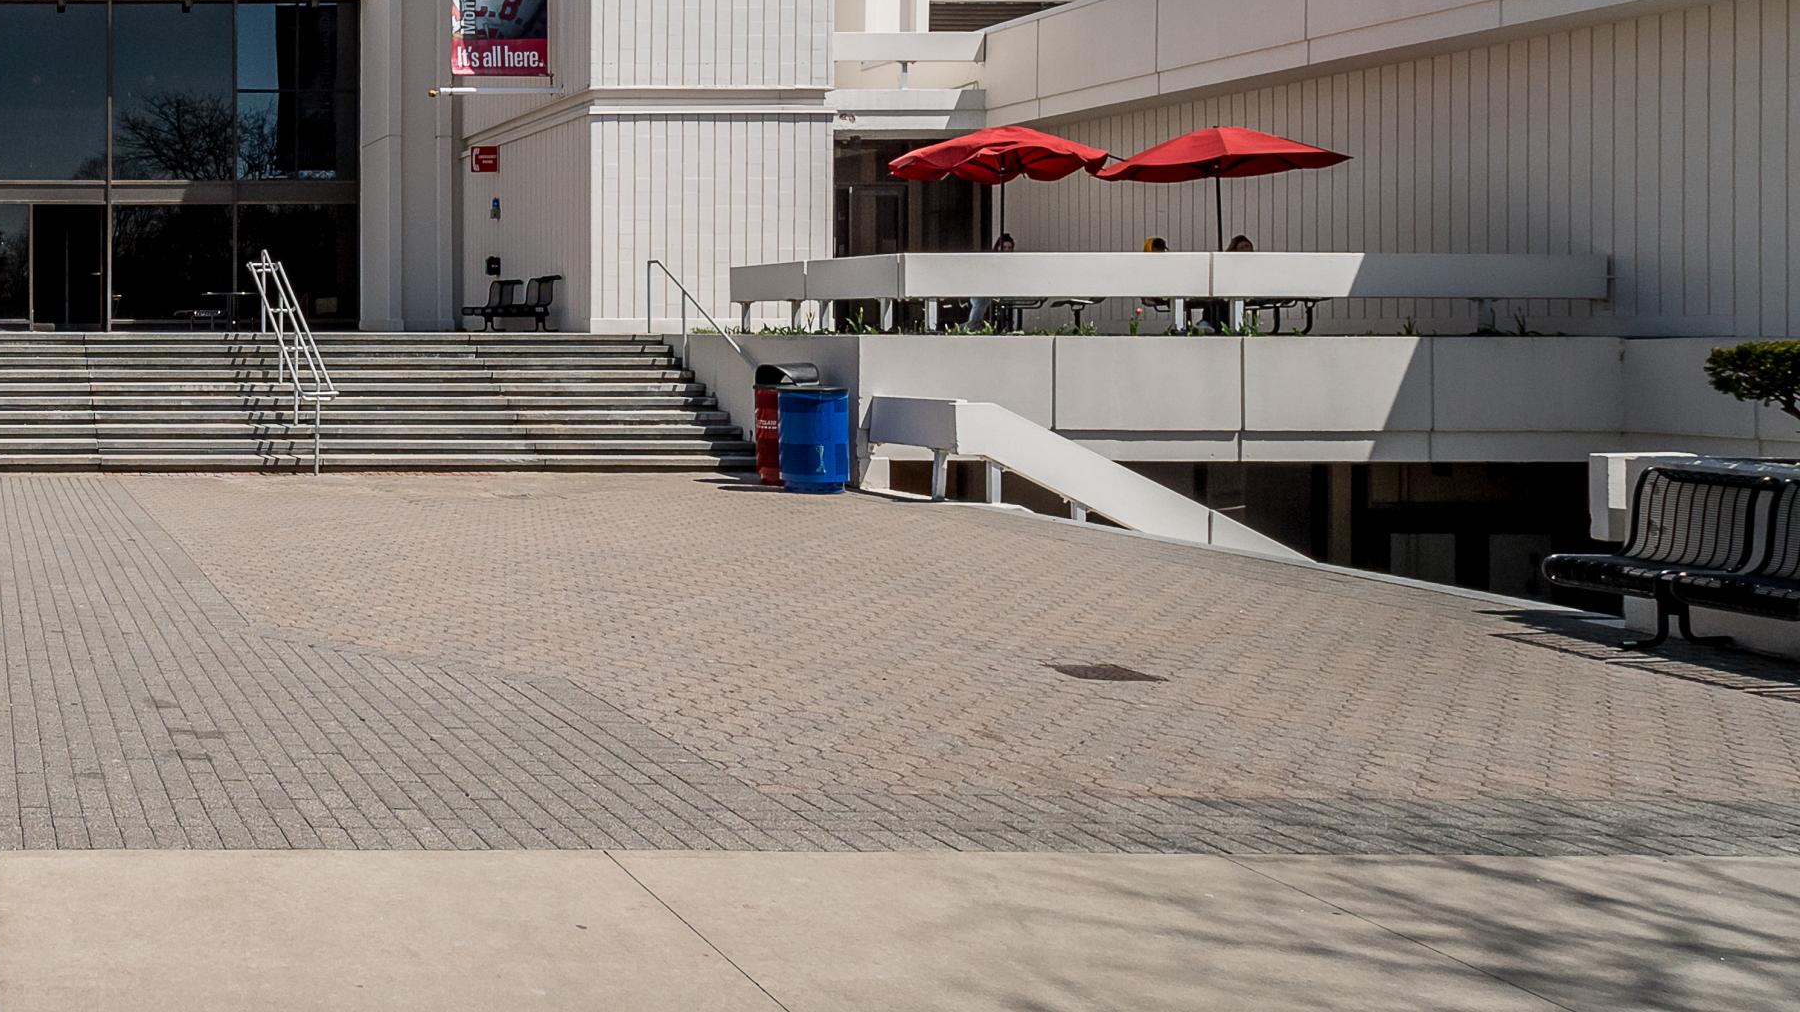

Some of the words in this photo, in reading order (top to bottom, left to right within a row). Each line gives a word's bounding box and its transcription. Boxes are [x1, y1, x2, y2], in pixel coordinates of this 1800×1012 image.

[457, 45, 480, 68] It's
[482, 45, 501, 68] all
[504, 45, 544, 68] here.
